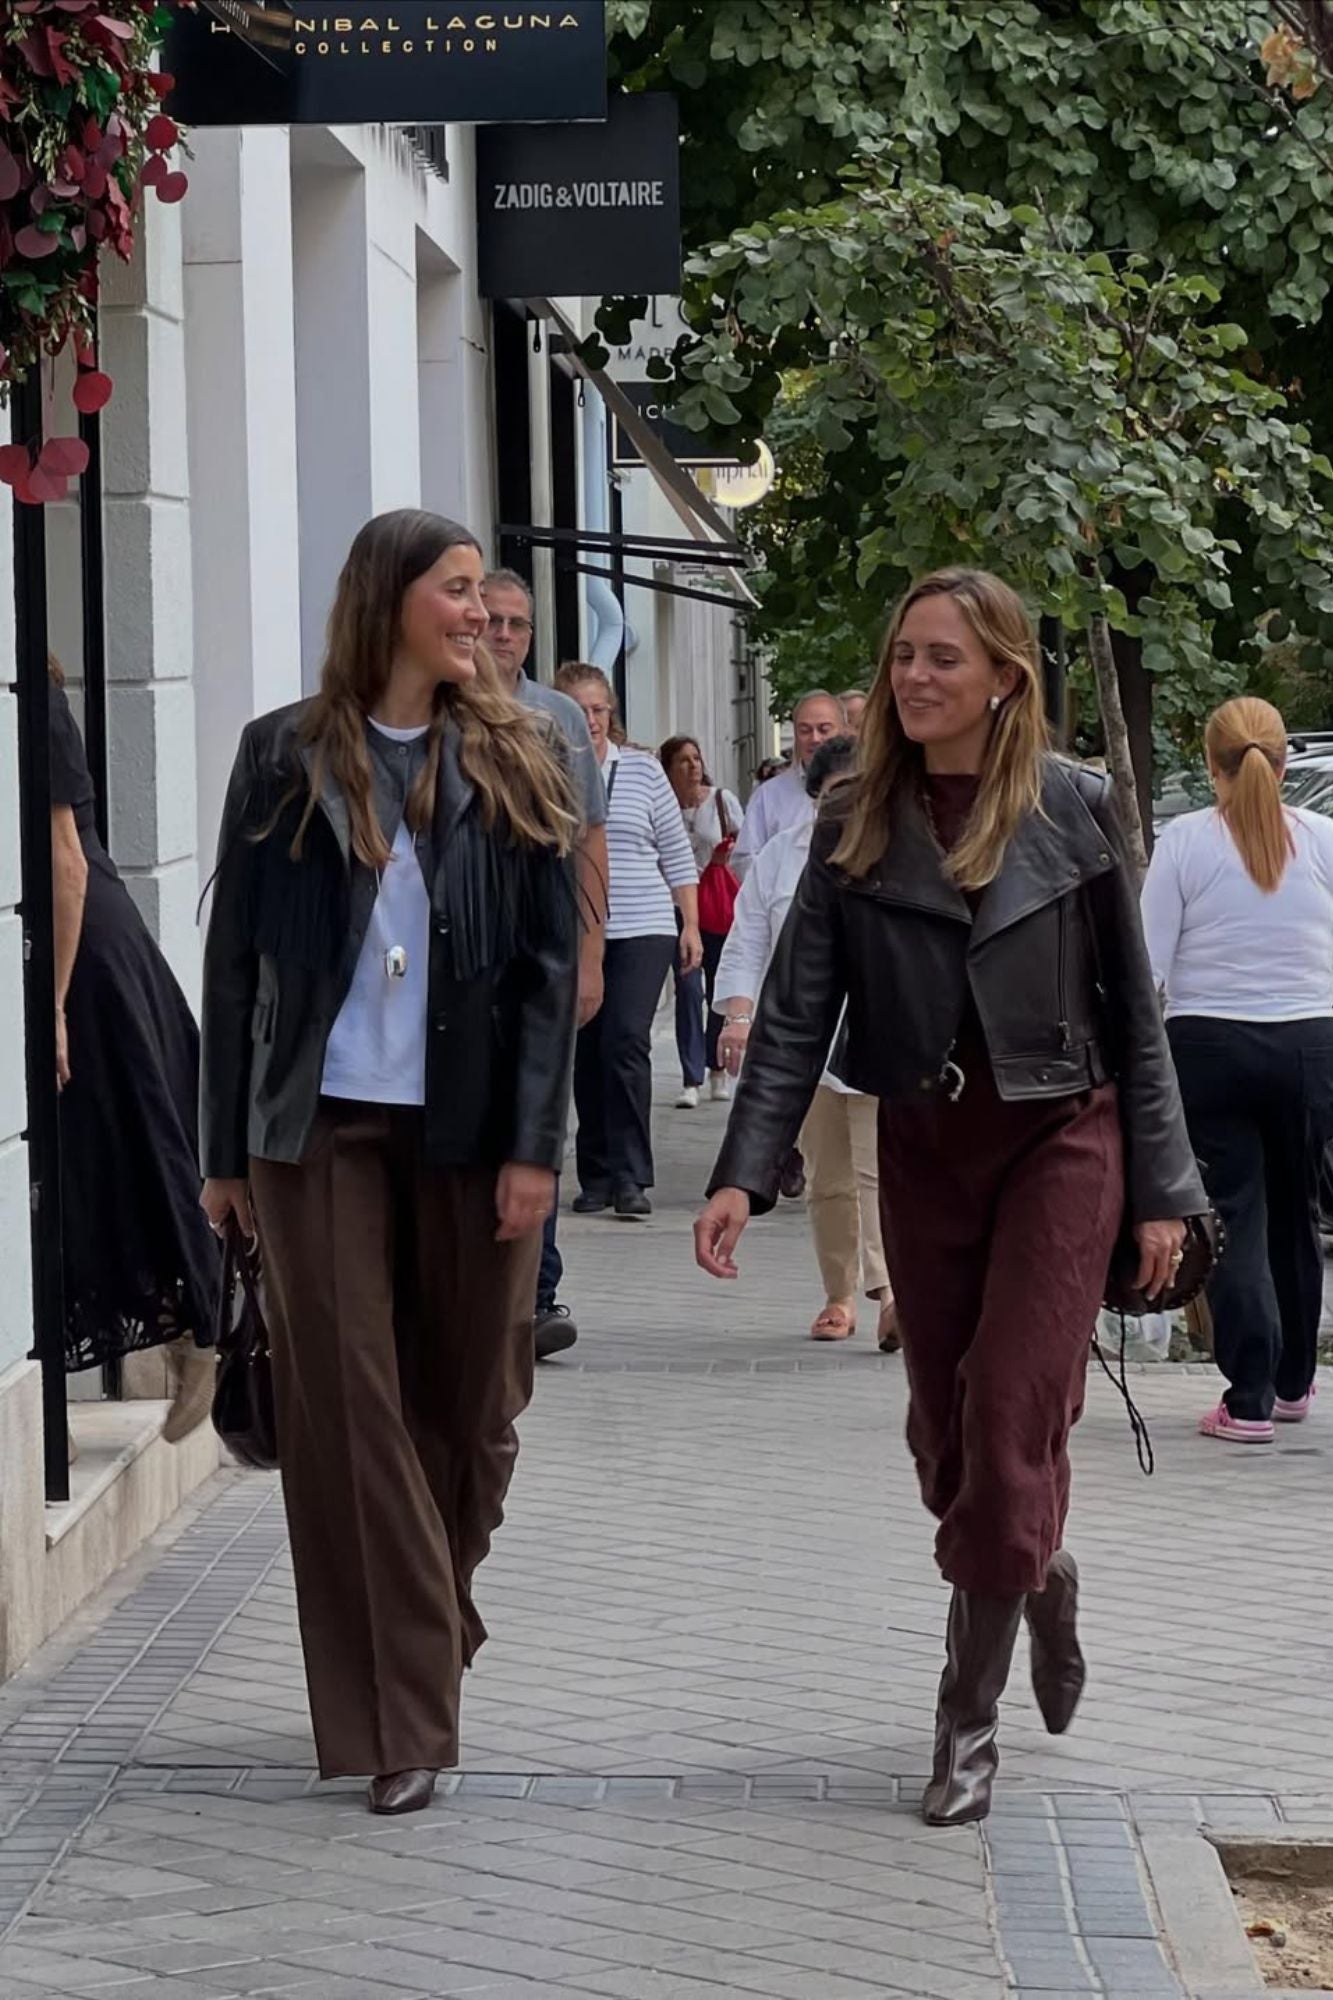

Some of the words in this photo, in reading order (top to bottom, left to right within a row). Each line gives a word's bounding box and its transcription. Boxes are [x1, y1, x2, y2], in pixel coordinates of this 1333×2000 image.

[211, 18, 400, 34] HNIBAL
[427, 14, 579, 30] LAGUNA
[294, 39, 497, 55] COLLECTION
[494, 181, 664, 209] ZADIG&VOLTAIRE
